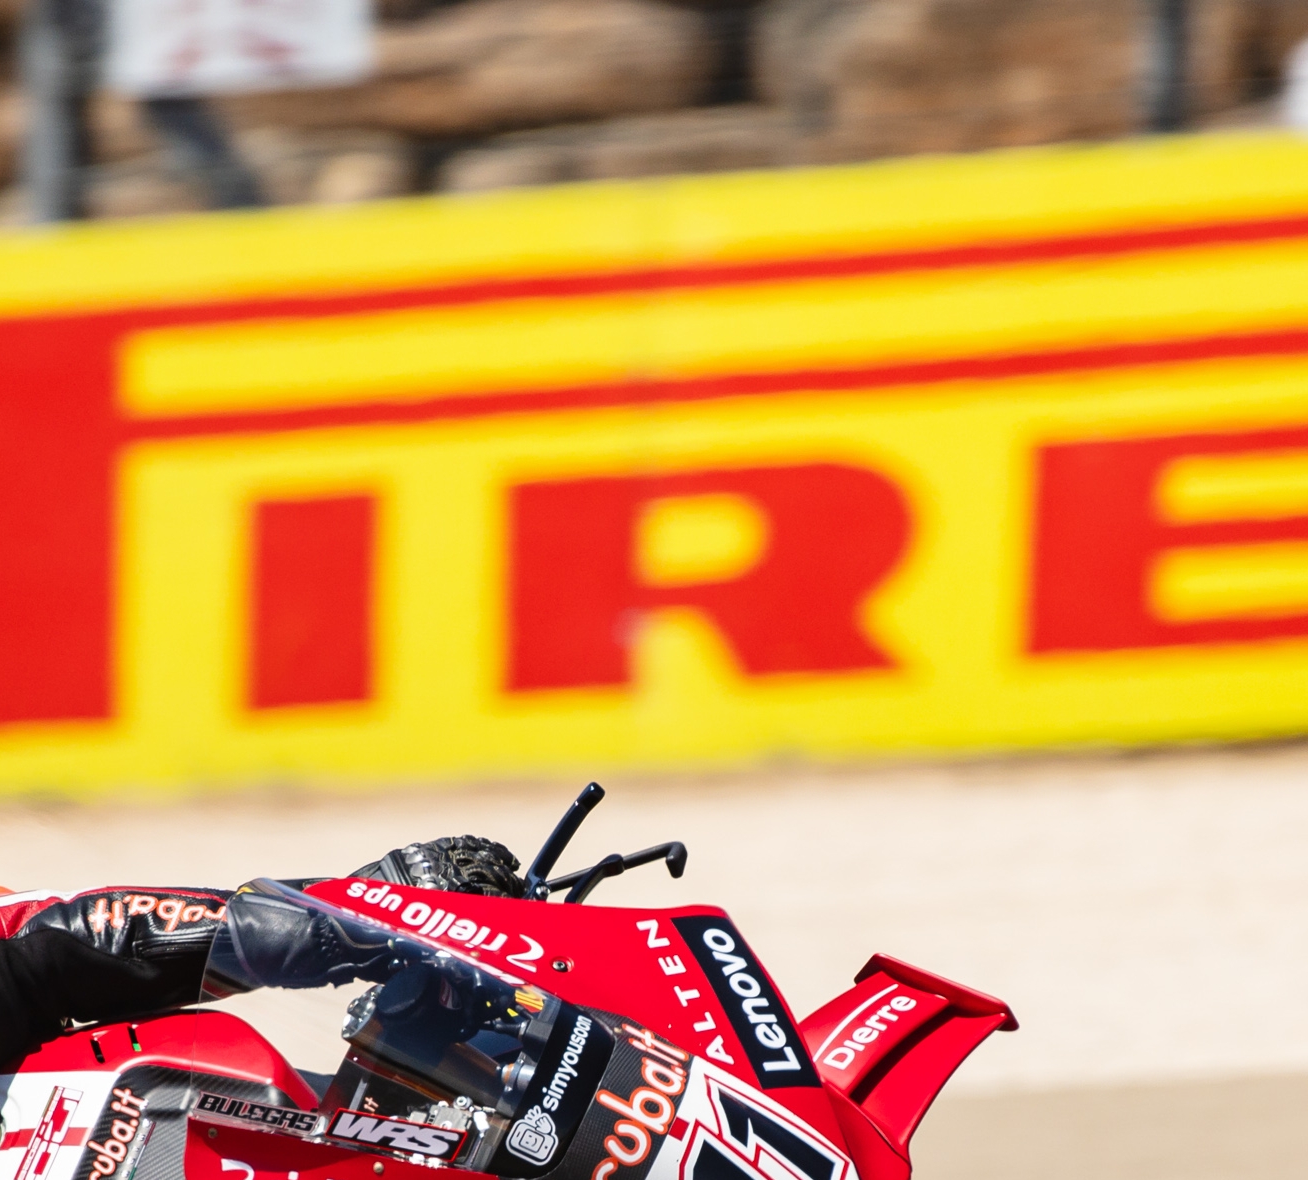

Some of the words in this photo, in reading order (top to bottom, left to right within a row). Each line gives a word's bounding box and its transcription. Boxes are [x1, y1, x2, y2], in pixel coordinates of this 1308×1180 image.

[88, 894, 227, 933] ruba.it
[346, 881, 403, 912] ups
[400, 901, 509, 951] riello
[636, 919, 736, 1067] ALTEN
[702, 927, 802, 1074] Lenovo
[543, 1014, 593, 1113] simyousoon
[196, 1093, 318, 1132] BULEGAS
[332, 1112, 460, 1155] WRS
